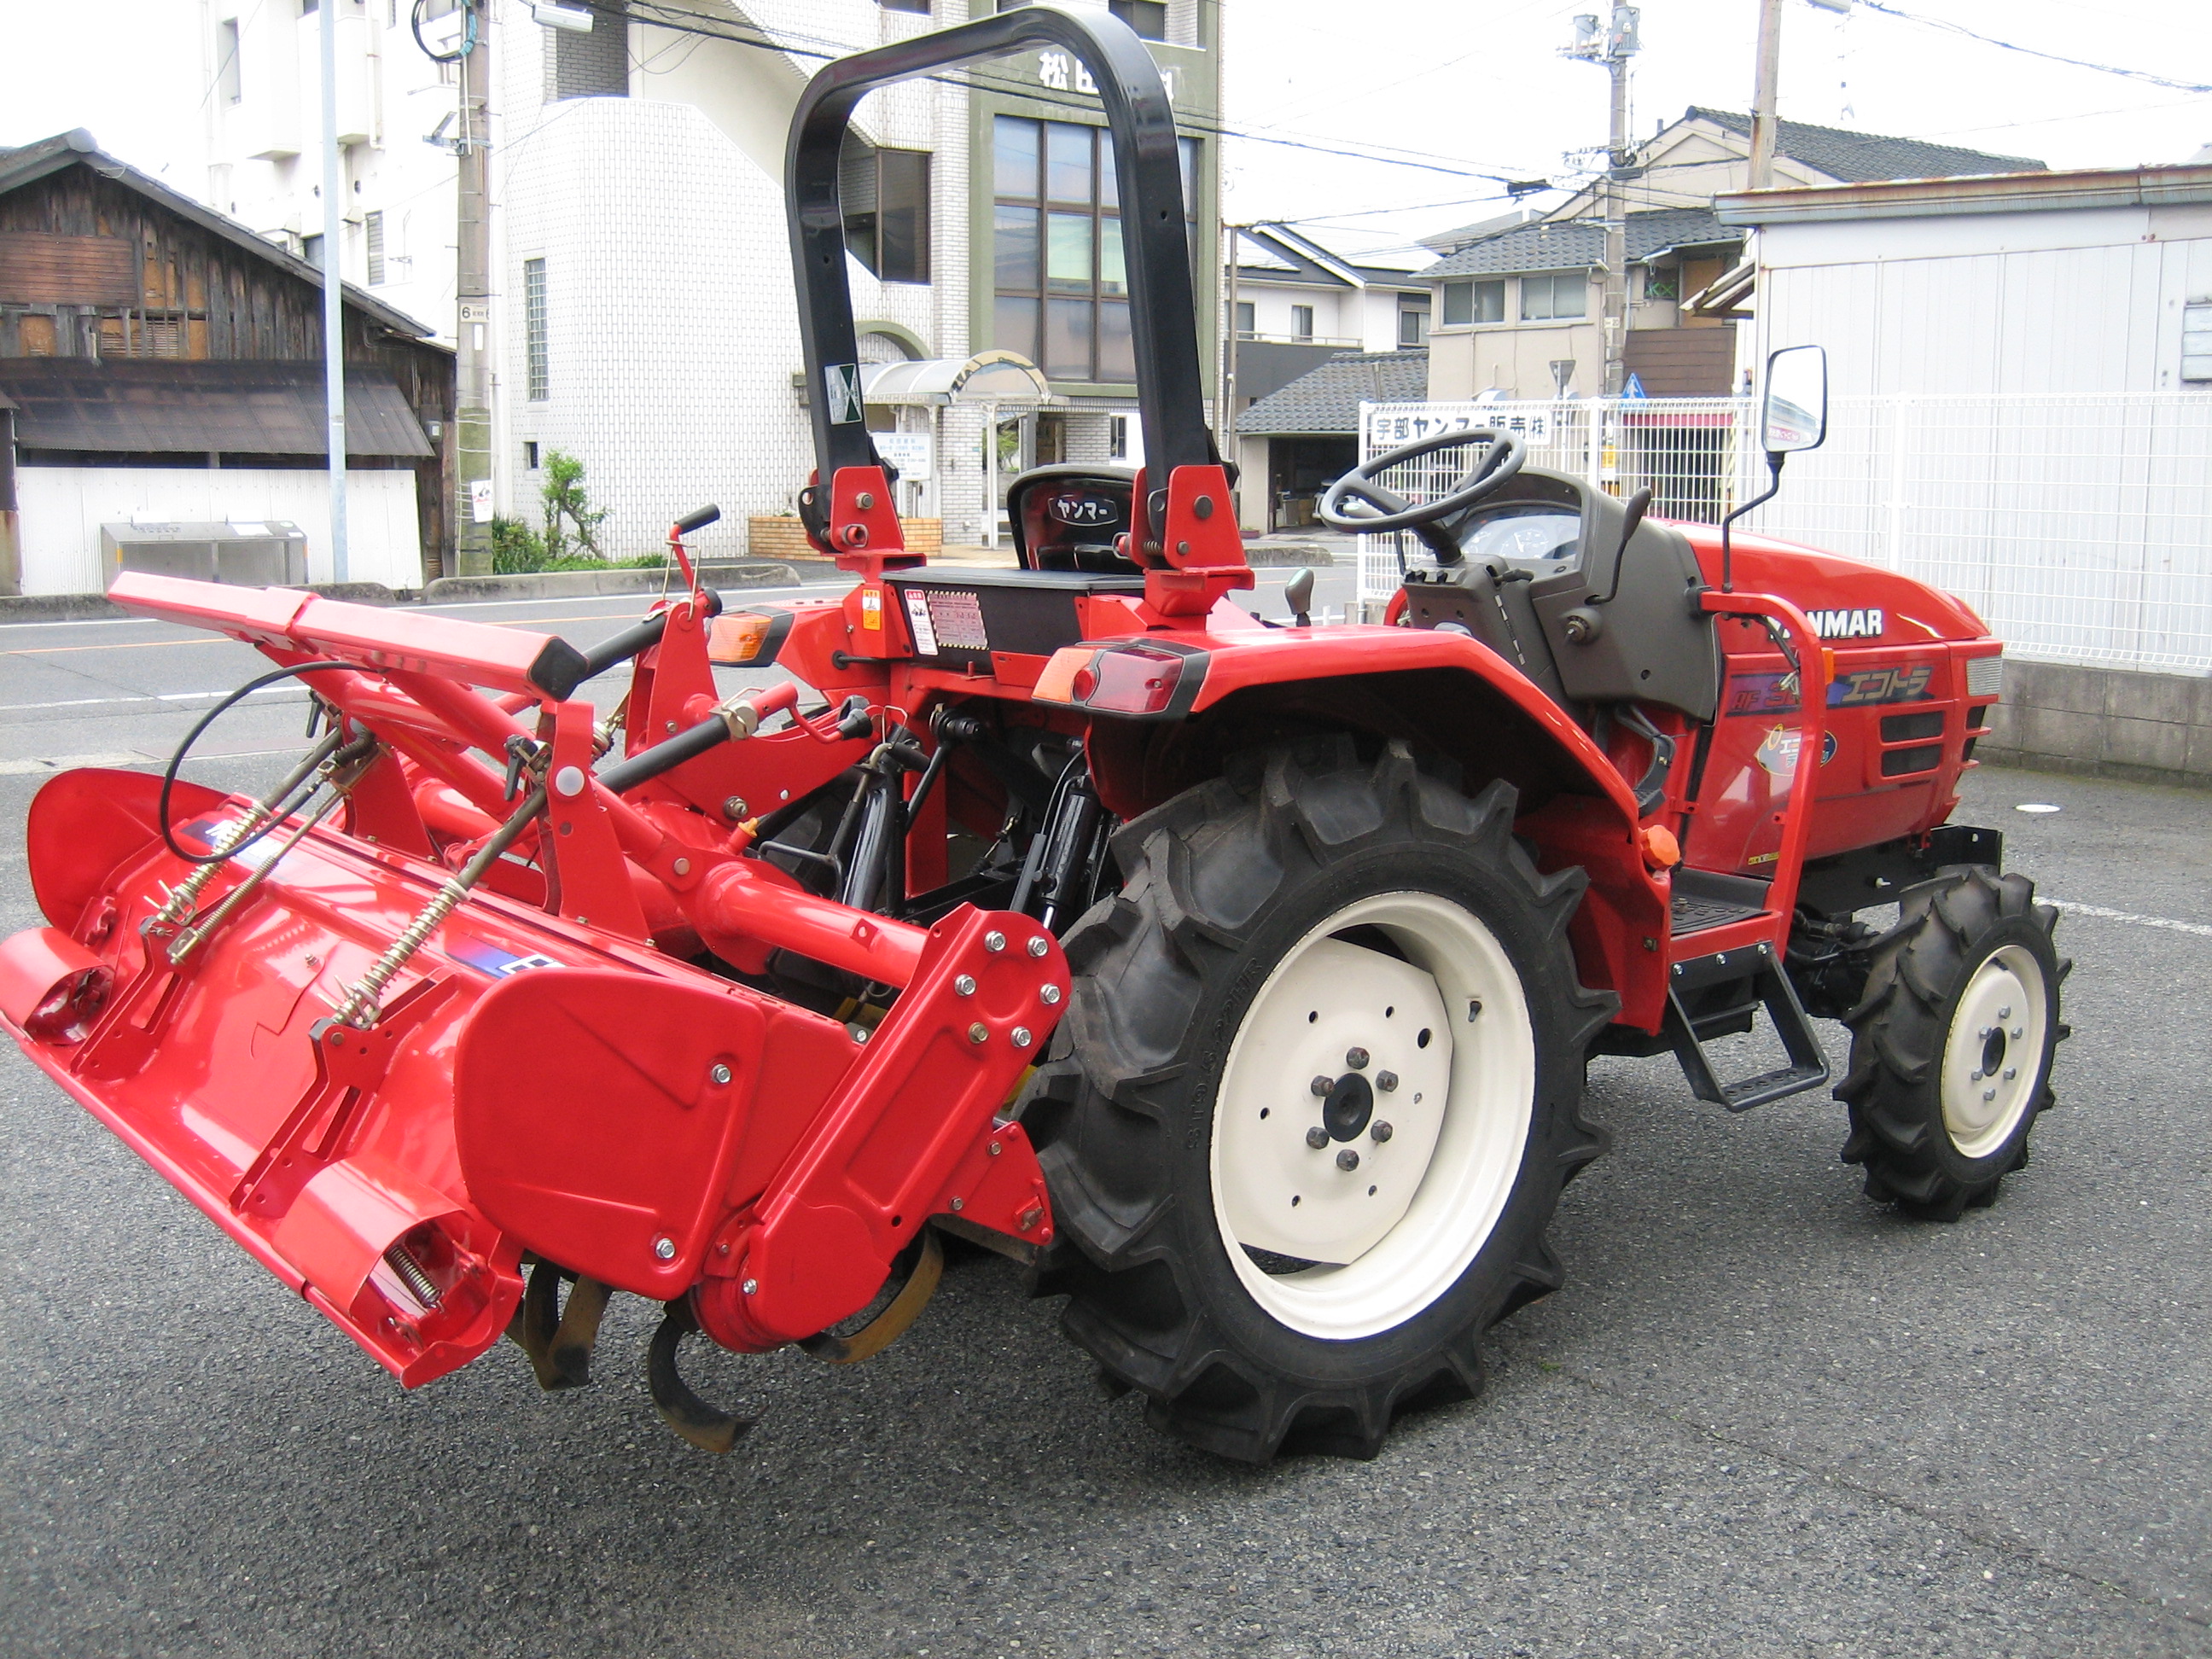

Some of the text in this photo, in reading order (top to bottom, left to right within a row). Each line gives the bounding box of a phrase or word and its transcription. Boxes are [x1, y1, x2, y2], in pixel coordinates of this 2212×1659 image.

[1057, 499, 1108, 520] ヤンマー
[1766, 608, 1883, 639] NMAR
[1842, 669, 1931, 701] エコトラ
